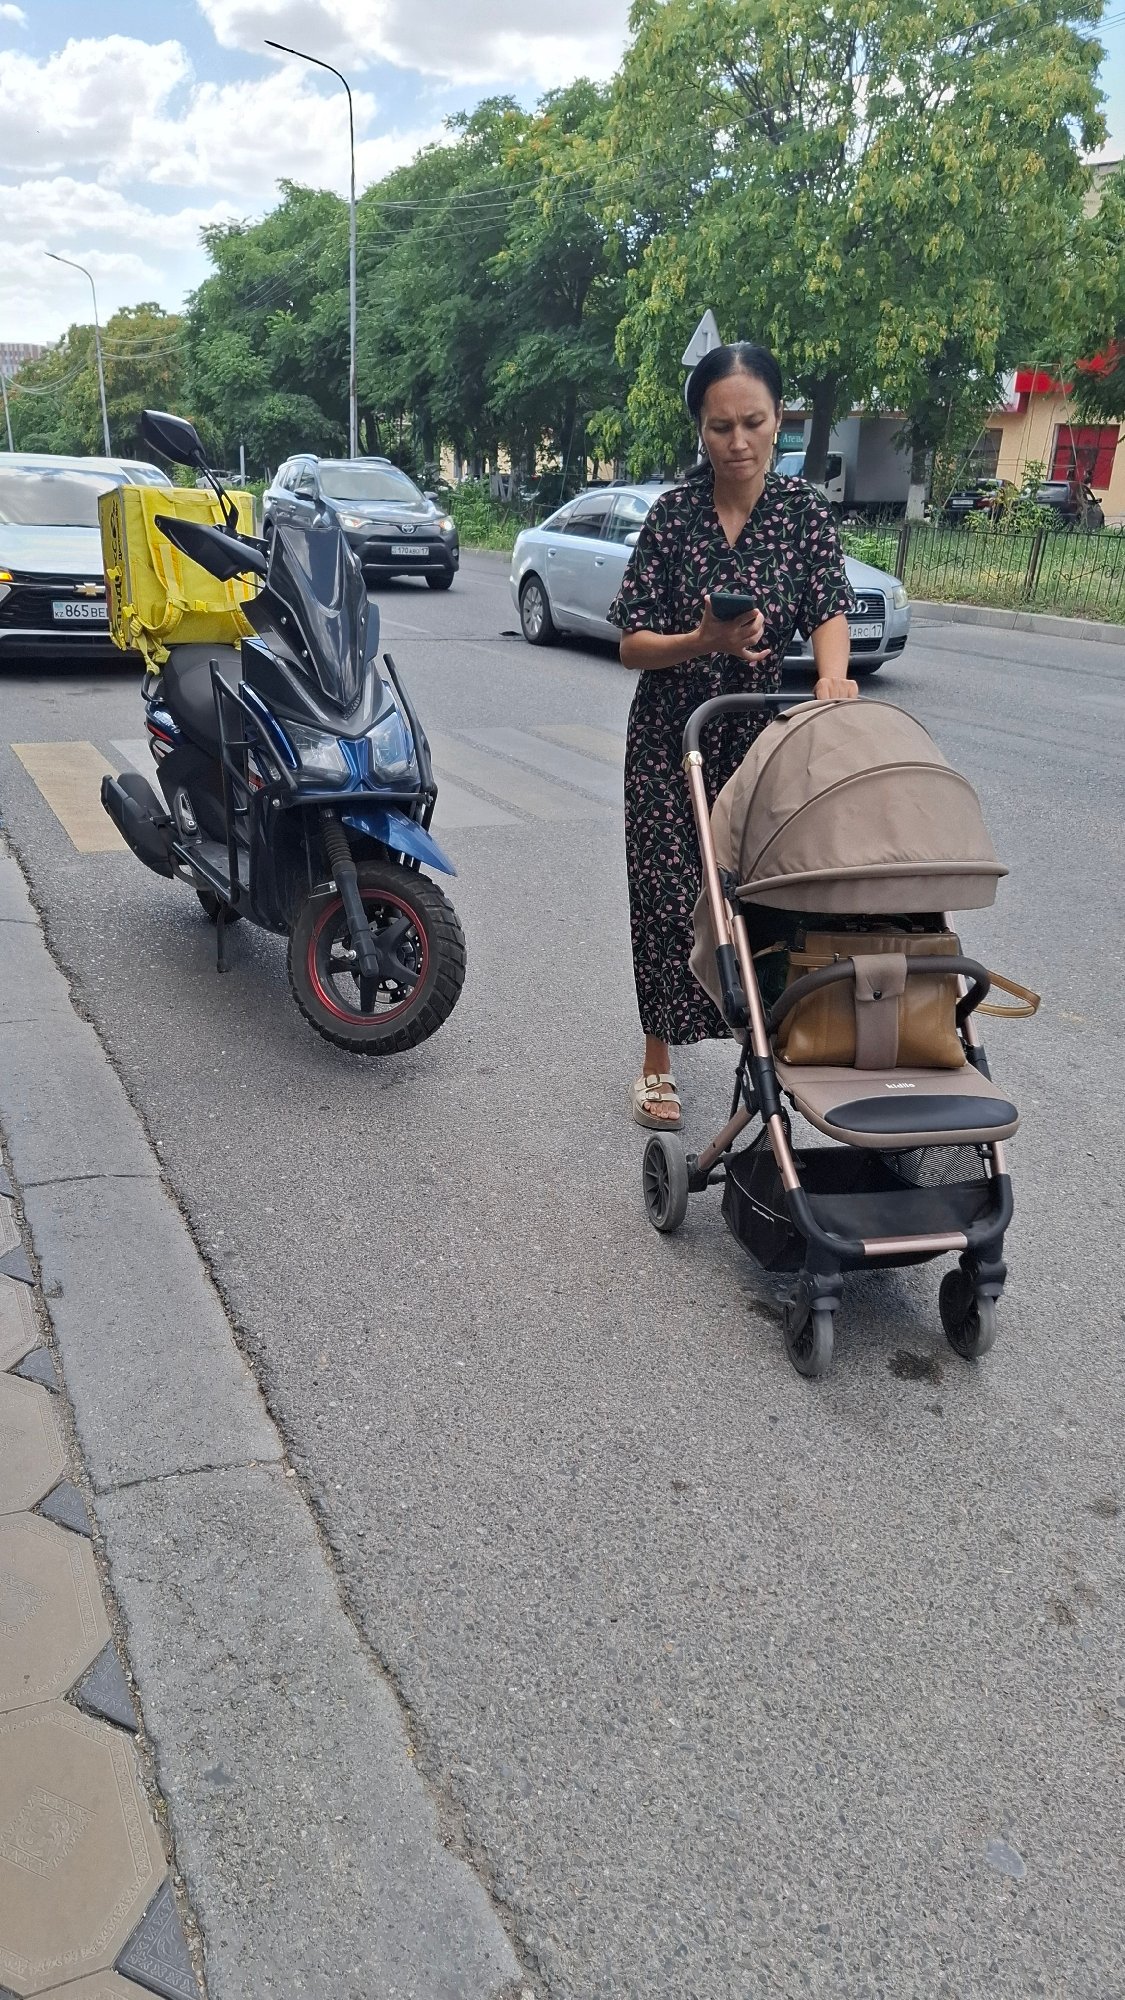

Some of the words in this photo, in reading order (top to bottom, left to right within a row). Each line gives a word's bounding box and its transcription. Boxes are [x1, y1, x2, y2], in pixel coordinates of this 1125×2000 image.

[65, 604, 89, 617] 865
[90, 607, 109, 618] BE
[853, 627, 869, 637] ARC
[871, 624, 882, 637] 17
